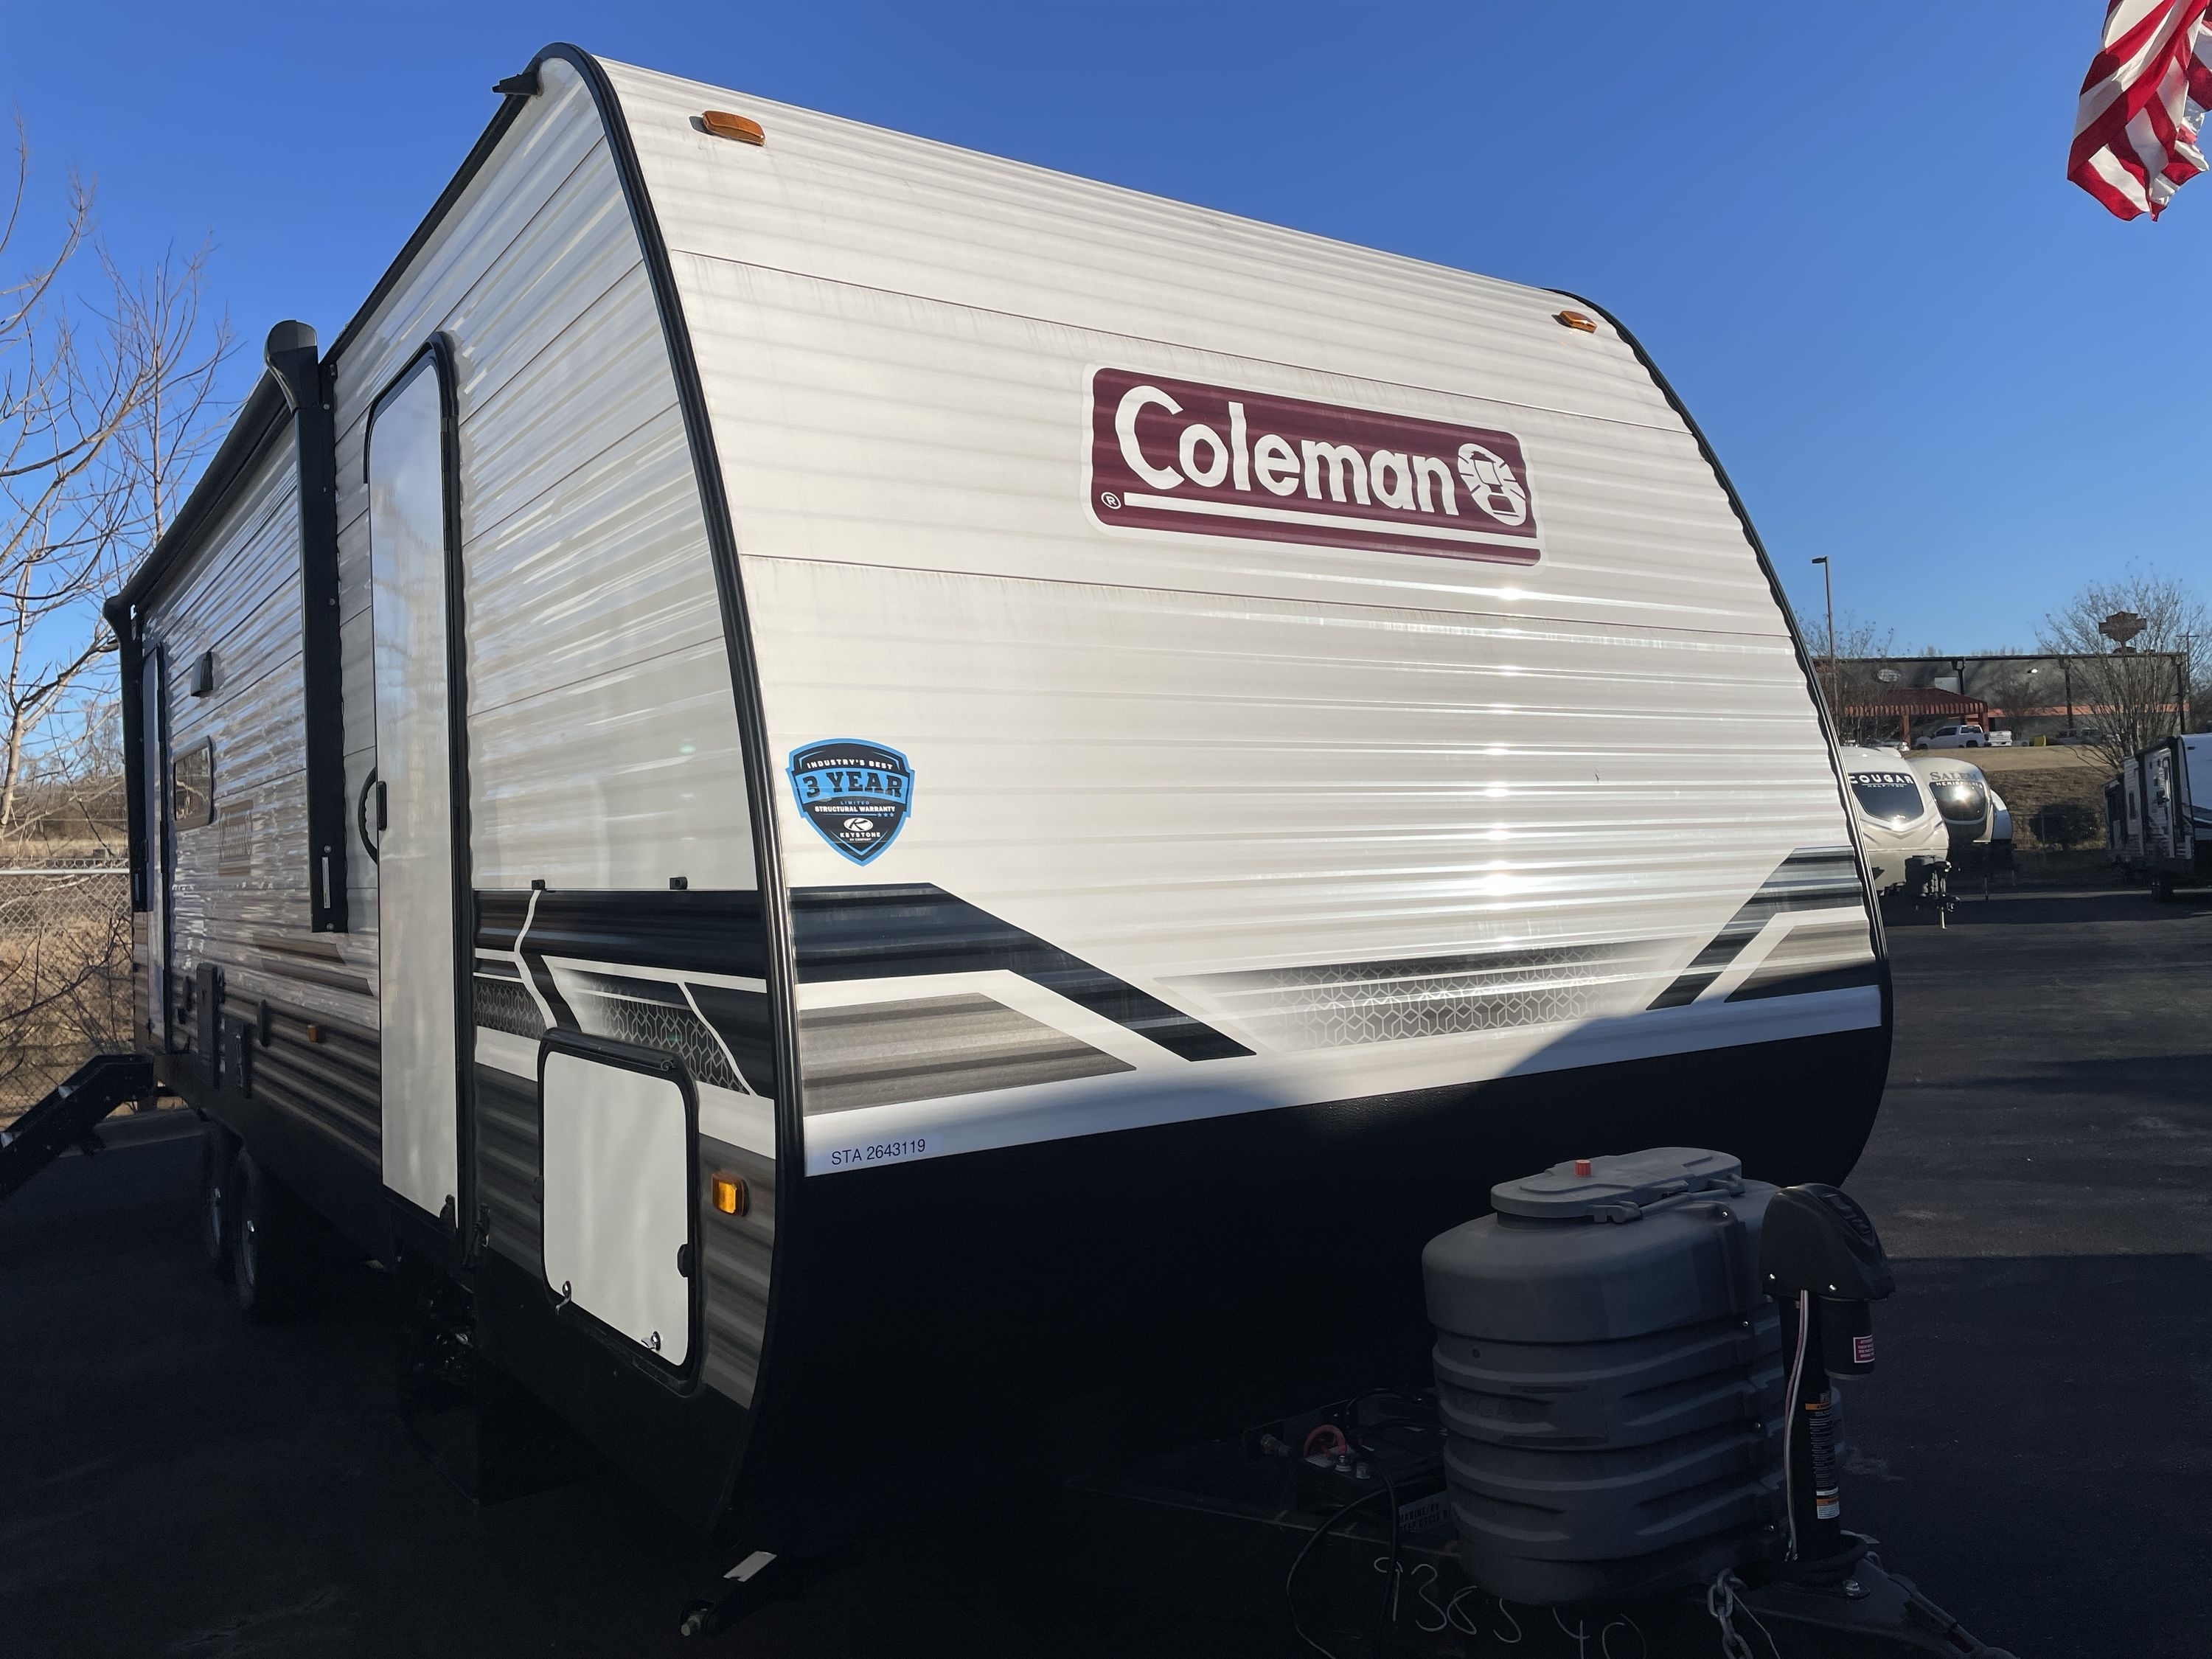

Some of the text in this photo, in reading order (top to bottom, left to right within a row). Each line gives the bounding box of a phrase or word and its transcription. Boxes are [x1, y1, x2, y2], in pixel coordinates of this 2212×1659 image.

[1114, 385, 1460, 516] Coleman
[807, 759, 894, 770] INDUSTRY'S BEST
[802, 771, 902, 799] 3 YEAR
[1848, 774, 1914, 784] COUGAR
[1930, 771, 1979, 781] SALEM
[831, 1138, 926, 1166] STA 2643119
